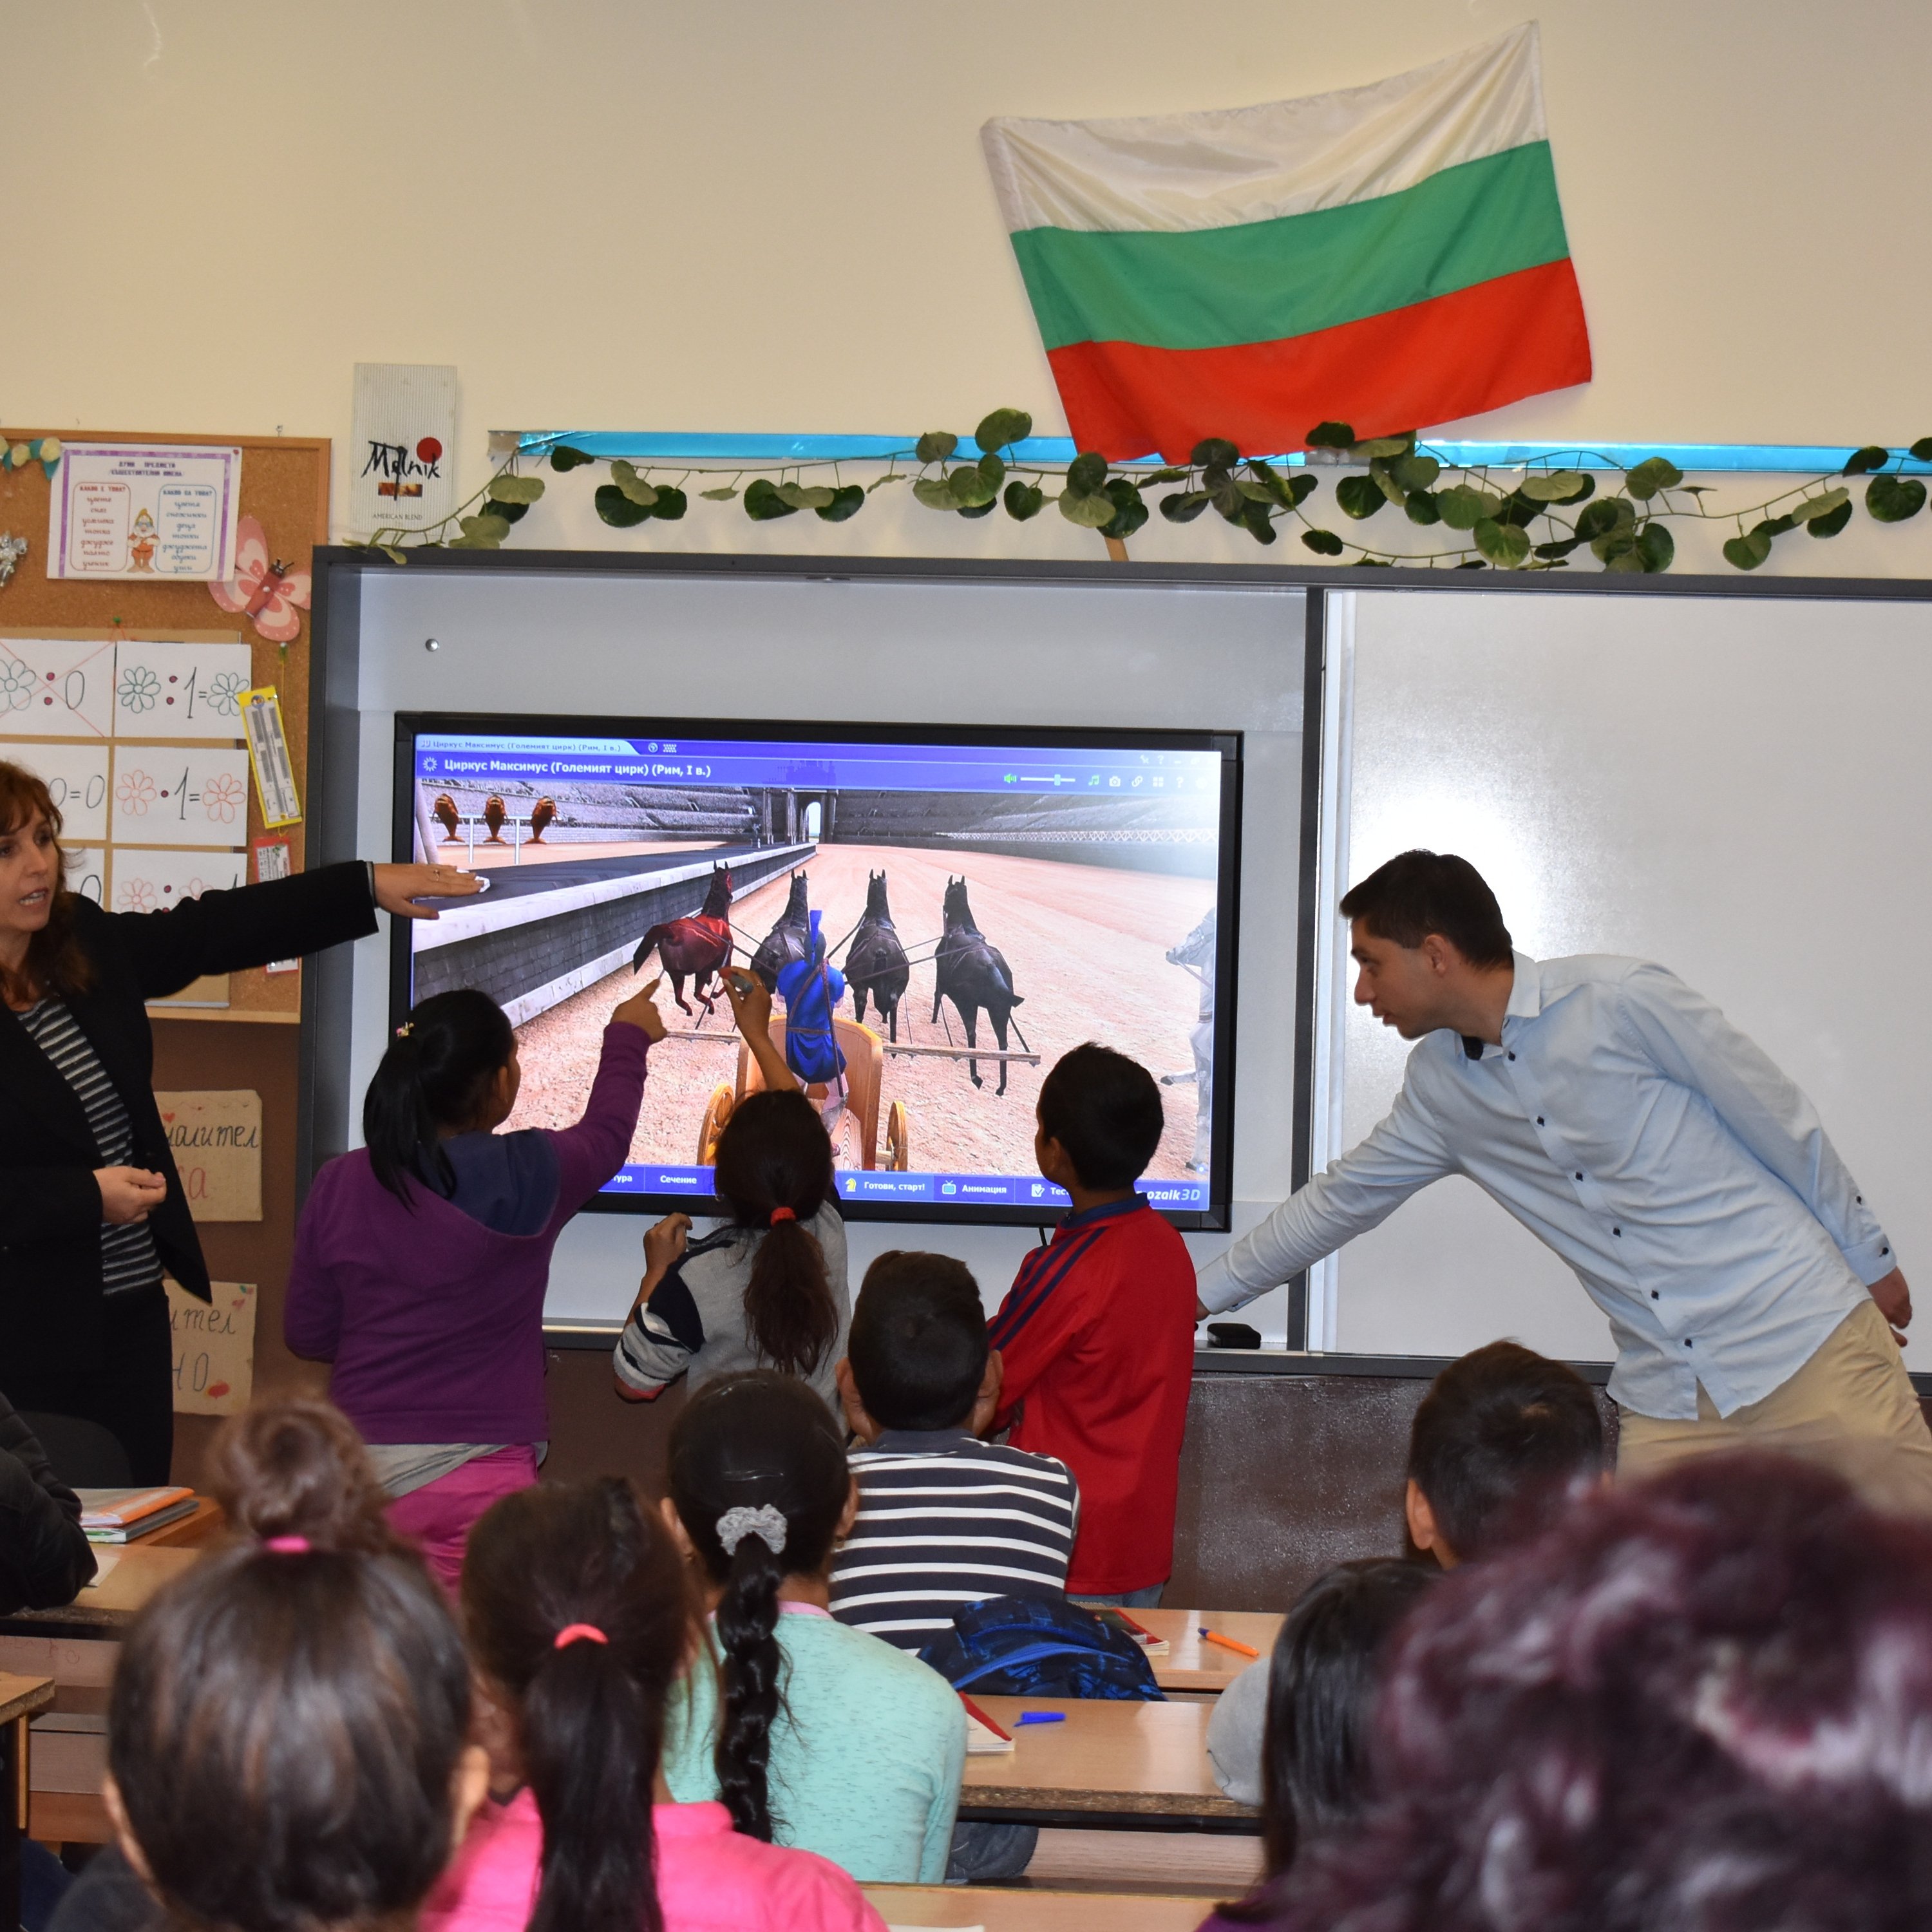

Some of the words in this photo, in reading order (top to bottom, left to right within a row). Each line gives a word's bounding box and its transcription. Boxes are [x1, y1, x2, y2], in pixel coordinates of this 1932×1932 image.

[361, 440, 440, 501] Melnik
[507, 741, 549, 750] (Големият
[553, 743, 576, 752] цирк)
[579, 744, 600, 752] (Рим,
[444, 759, 488, 773] Циркус
[490, 760, 548, 774] Максимус
[551, 761, 612, 775] (Големият
[614, 764, 649, 777] цирк)
[652, 764, 683, 777] (Рим,
[687, 765, 693, 775] I
[696, 765, 711, 778] в.)
[168, 1125, 258, 1148] алител
[660, 1175, 697, 1184] Сечение
[864, 1181, 896, 1191] Готови,
[898, 1182, 925, 1192] старт!
[962, 1184, 1007, 1195] Анимация
[1136, 1189, 1200, 1201] ozaik3D
